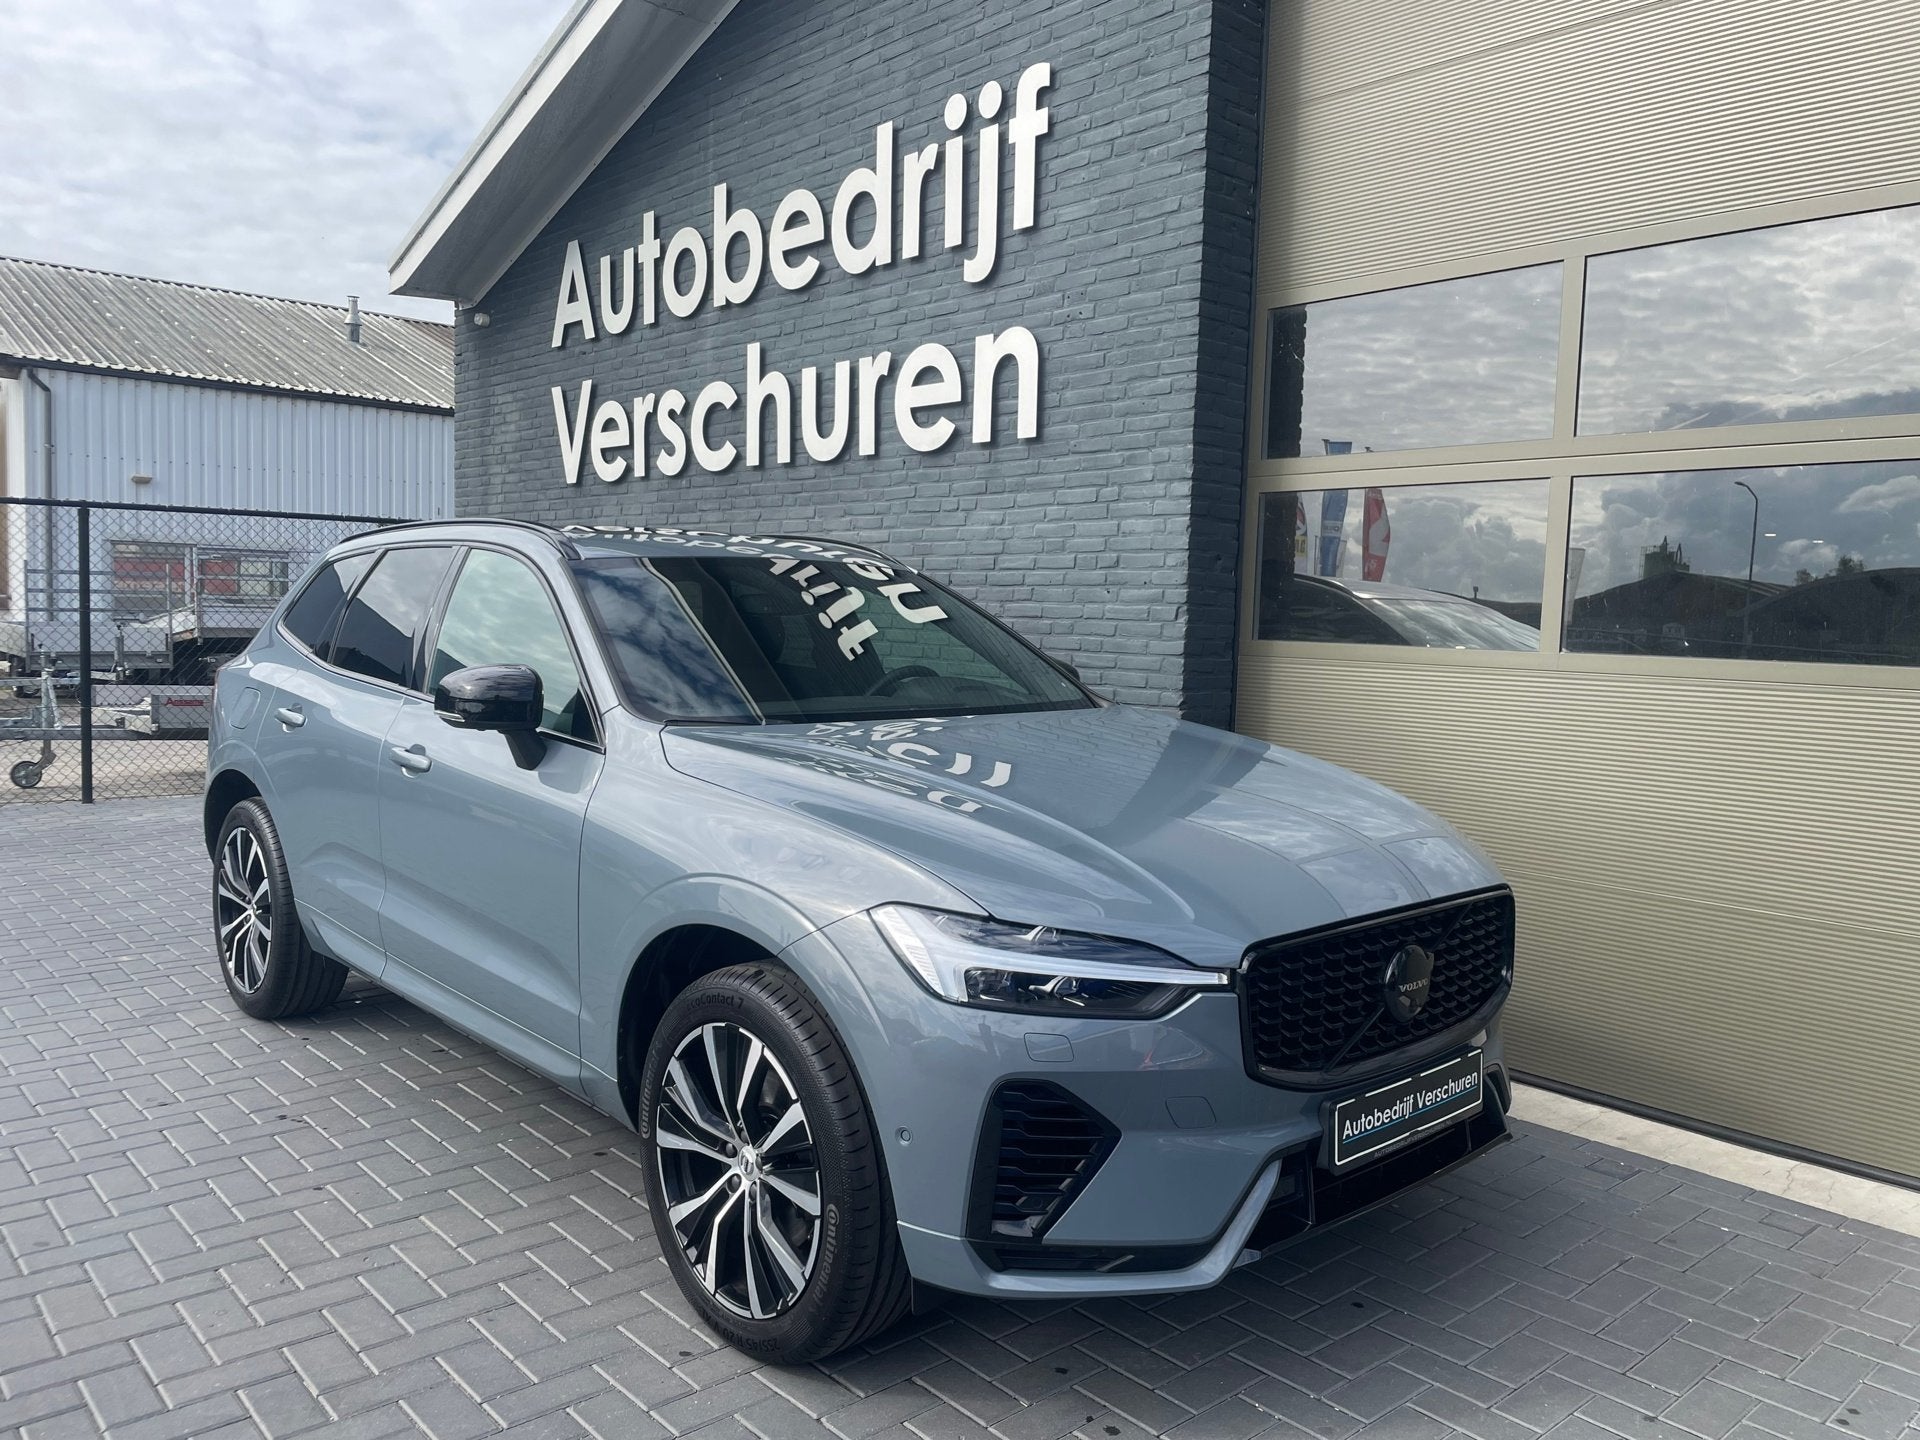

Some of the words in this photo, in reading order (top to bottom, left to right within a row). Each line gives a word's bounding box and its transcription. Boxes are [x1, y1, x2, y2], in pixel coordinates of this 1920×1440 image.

[551, 62, 1051, 348] Autobedrijf
[551, 326, 1040, 484] Verschuren
[1399, 978, 1429, 992] VOLVO
[1342, 1094, 1414, 1140] Autobedrijf
[1416, 1072, 1478, 1109] Verschuren
[812, 1203, 840, 1305] Continental
